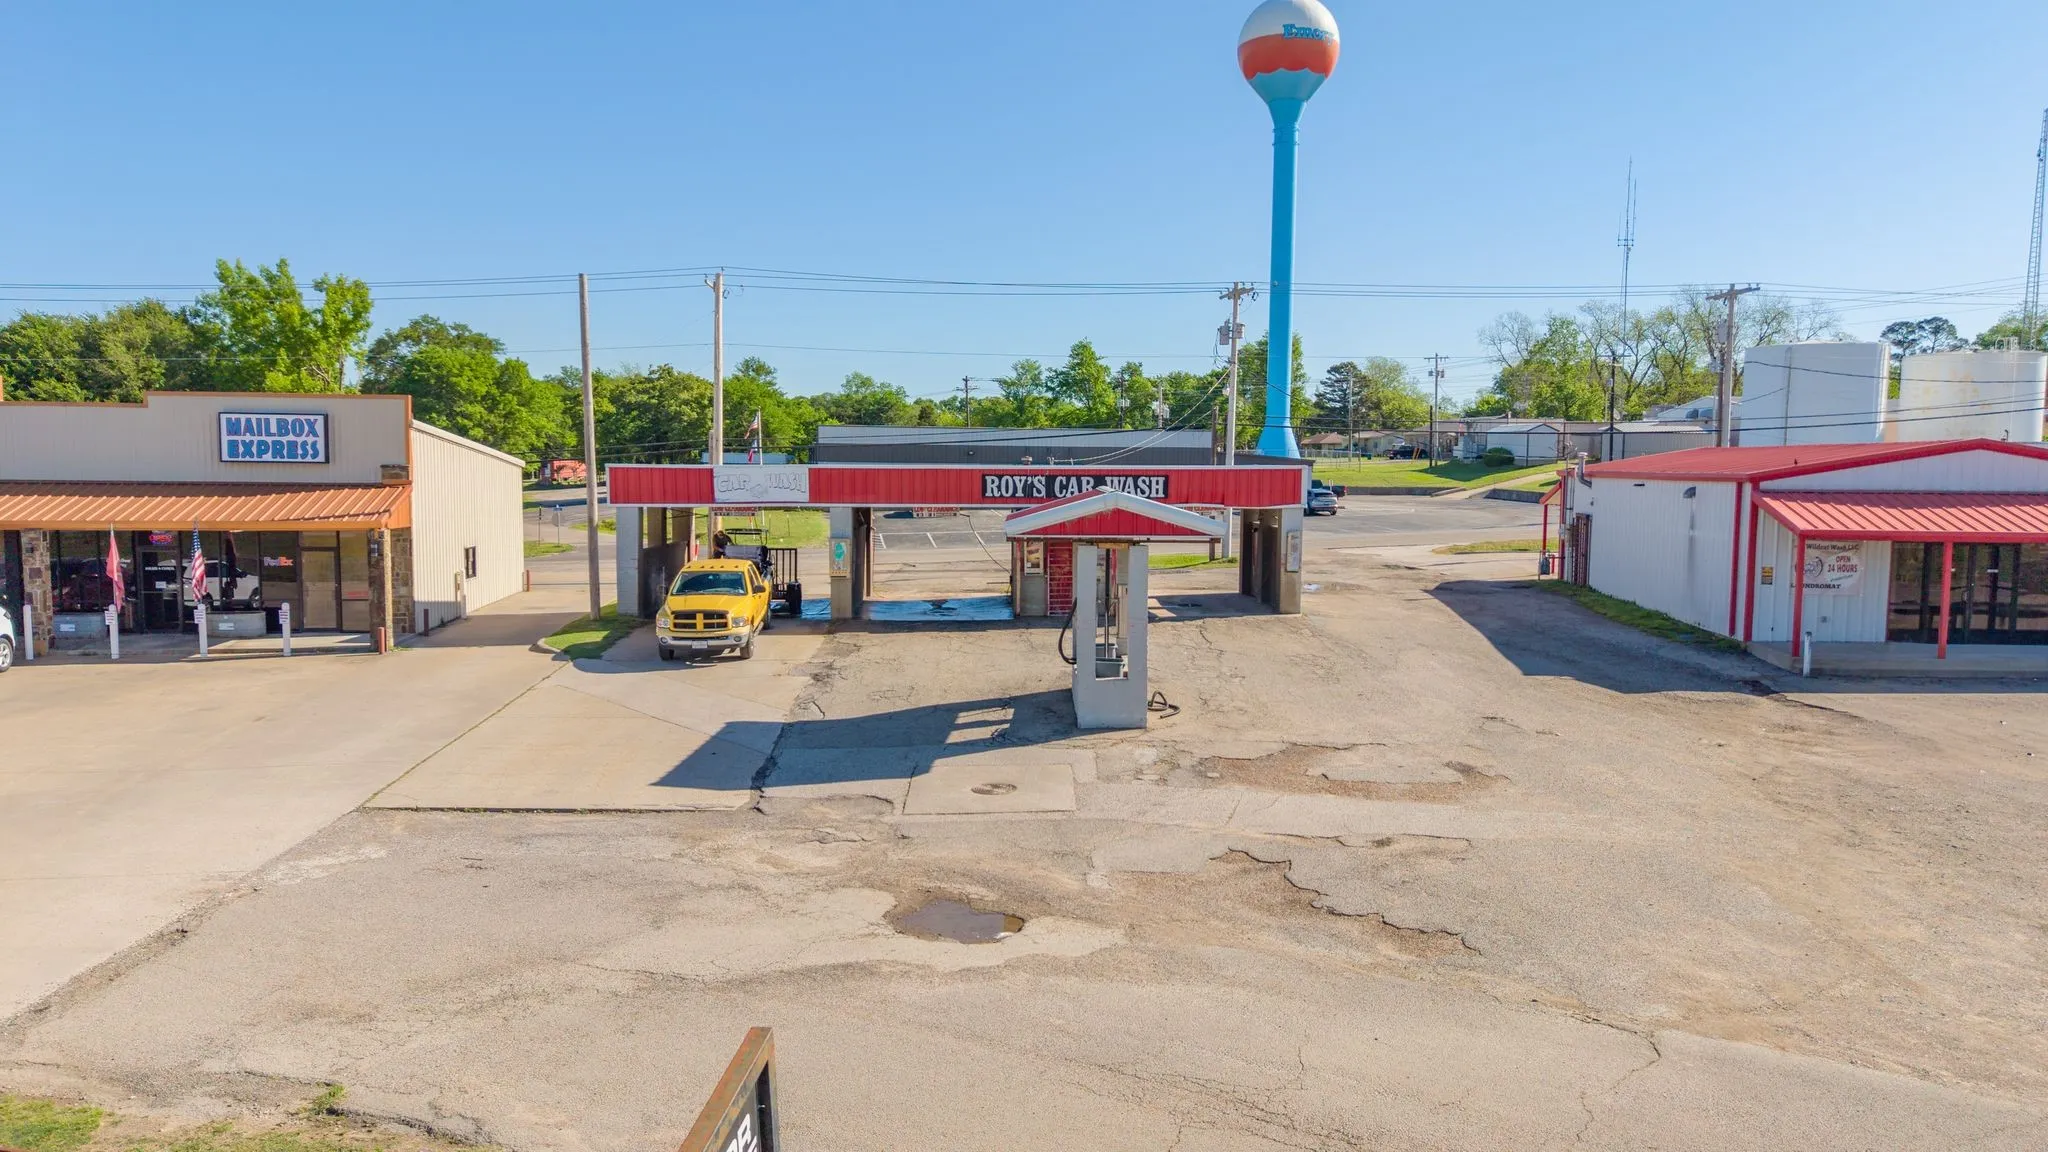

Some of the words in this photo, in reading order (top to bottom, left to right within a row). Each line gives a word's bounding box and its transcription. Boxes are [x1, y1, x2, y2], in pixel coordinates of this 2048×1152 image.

[225, 417, 320, 438] MAILBOX
[226, 439, 320, 460] EXPRESS
[717, 473, 751, 493] CAR
[767, 471, 807, 494] WASH
[984, 475, 1046, 498] ROY'S
[1053, 476, 1095, 498] CAR
[1105, 476, 1166, 498] WASH
[263, 556, 294, 567] FedEx
[1835, 555, 1851, 563] OPEN
[1836, 563, 1858, 573] HOURS
